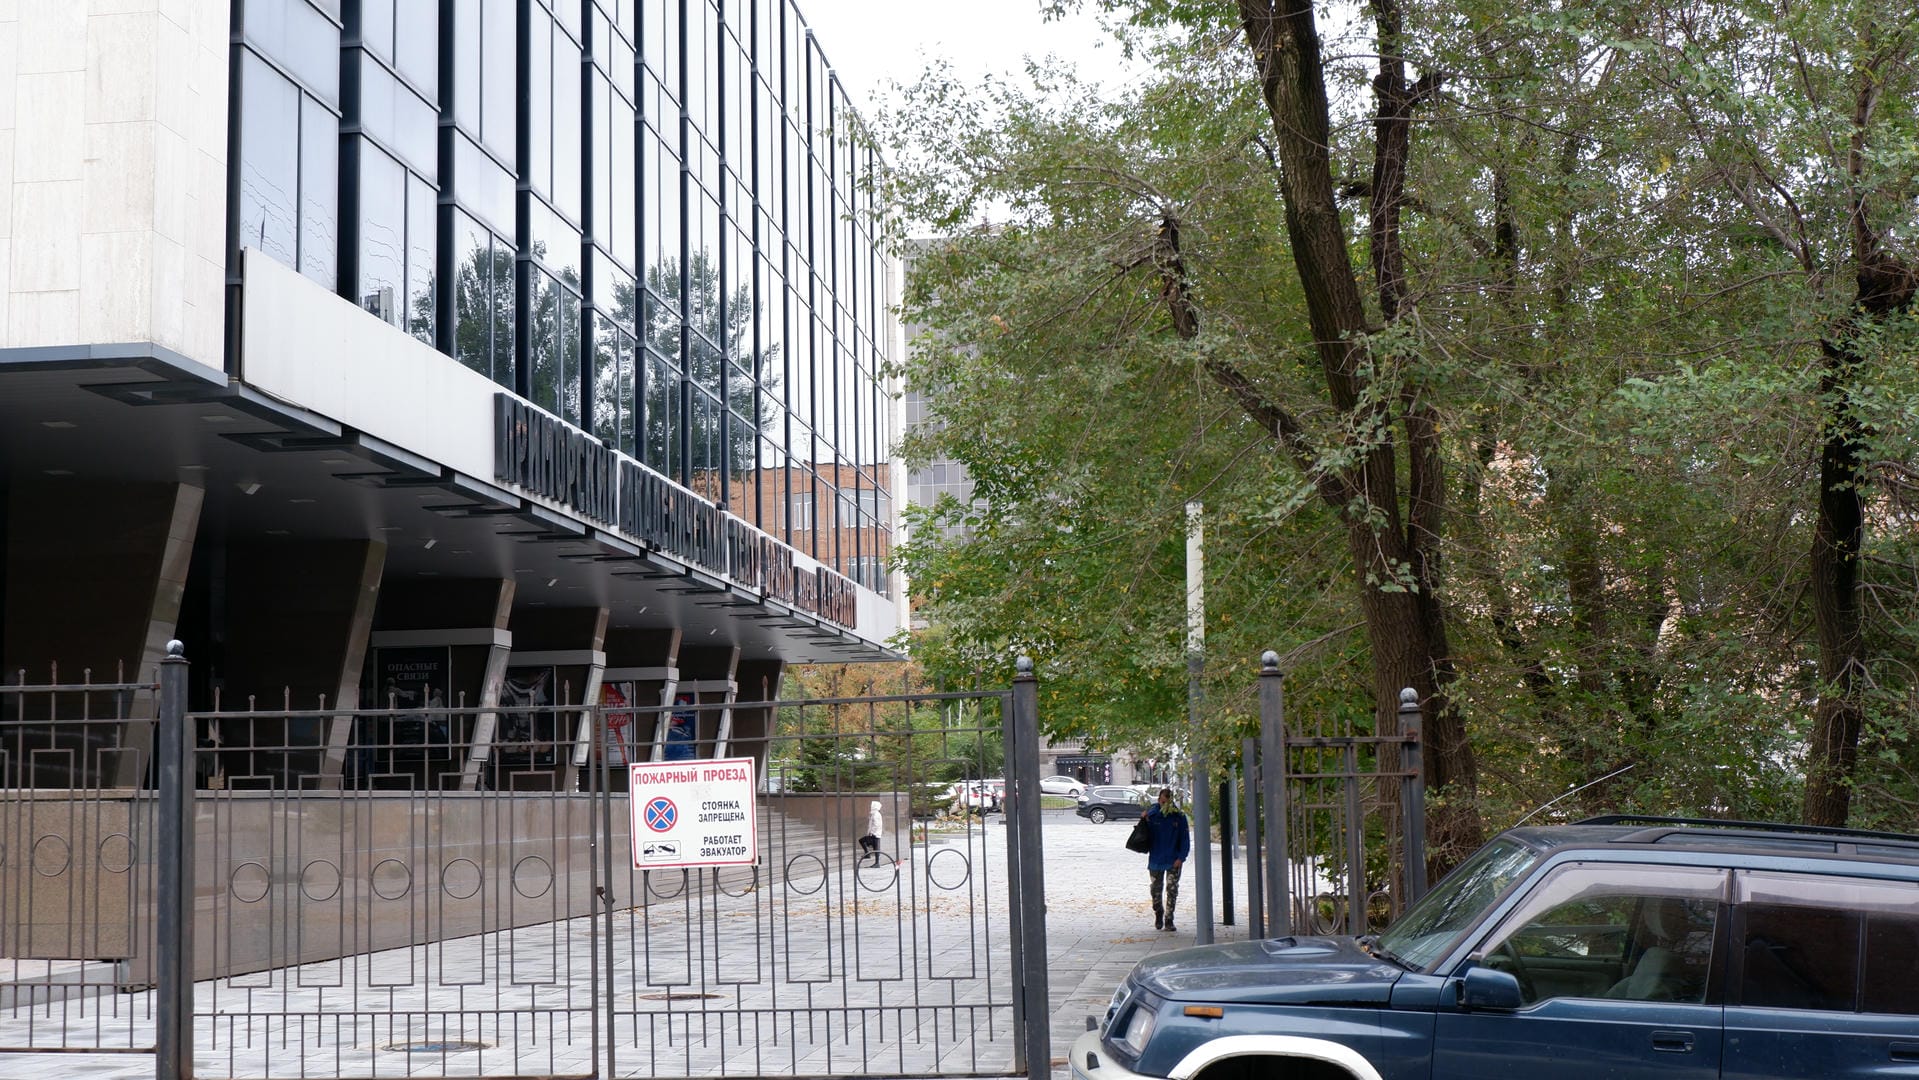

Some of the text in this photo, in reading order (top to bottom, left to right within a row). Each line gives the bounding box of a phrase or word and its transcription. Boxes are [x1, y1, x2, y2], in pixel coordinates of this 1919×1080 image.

[494, 392, 617, 525] ПРИМОРСКИЙ
[387, 662, 439, 672] ОПАСНЫЕ
[396, 672, 429, 681] СВЯЗИ
[635, 767, 747, 785] ПОЖАРНЫЙ ПРОЕЗД
[702, 800, 740, 811] СТОЯНКА
[698, 812, 745, 823] ЗАПРЕЩЕНА
[703, 835, 742, 845] РАБОТАЕТ
[700, 847, 747, 857] ЭВАКУАТОР
